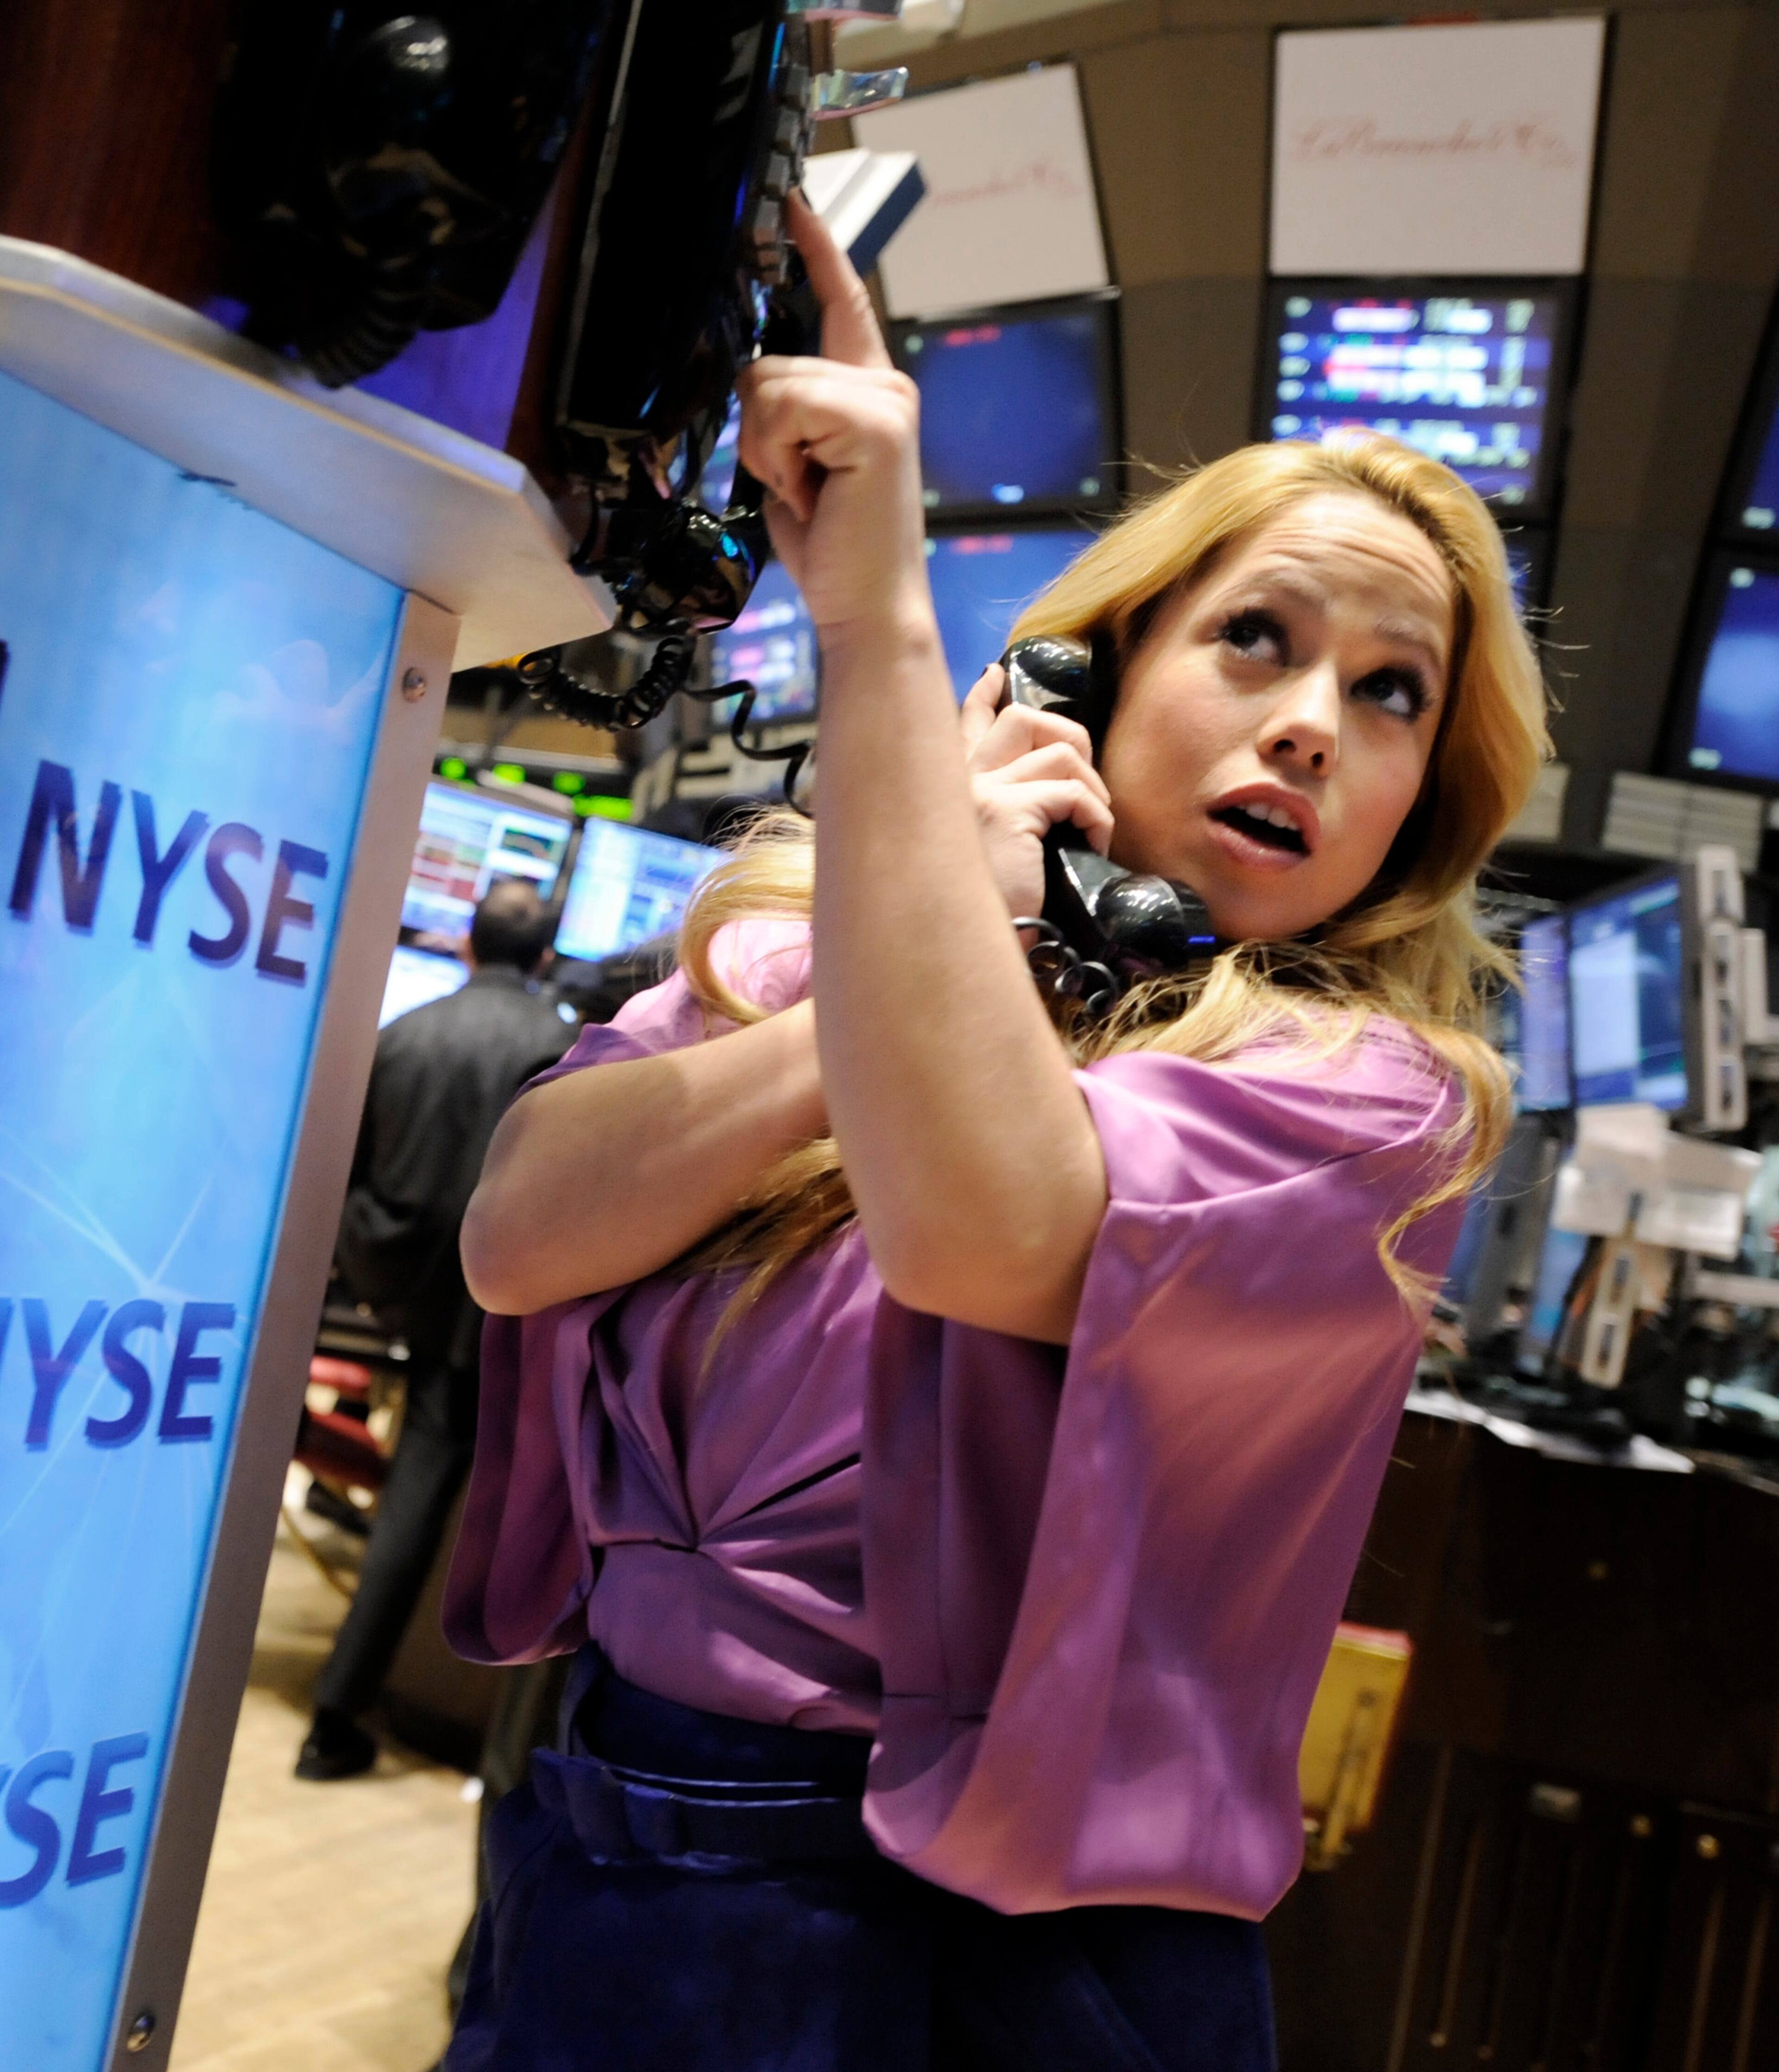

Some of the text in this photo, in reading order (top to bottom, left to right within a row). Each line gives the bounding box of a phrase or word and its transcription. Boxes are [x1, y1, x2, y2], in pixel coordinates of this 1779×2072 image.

[8, 760, 328, 987] NYSE
[0, 1297, 236, 1452] YSE
[0, 1731, 150, 1909] SE
